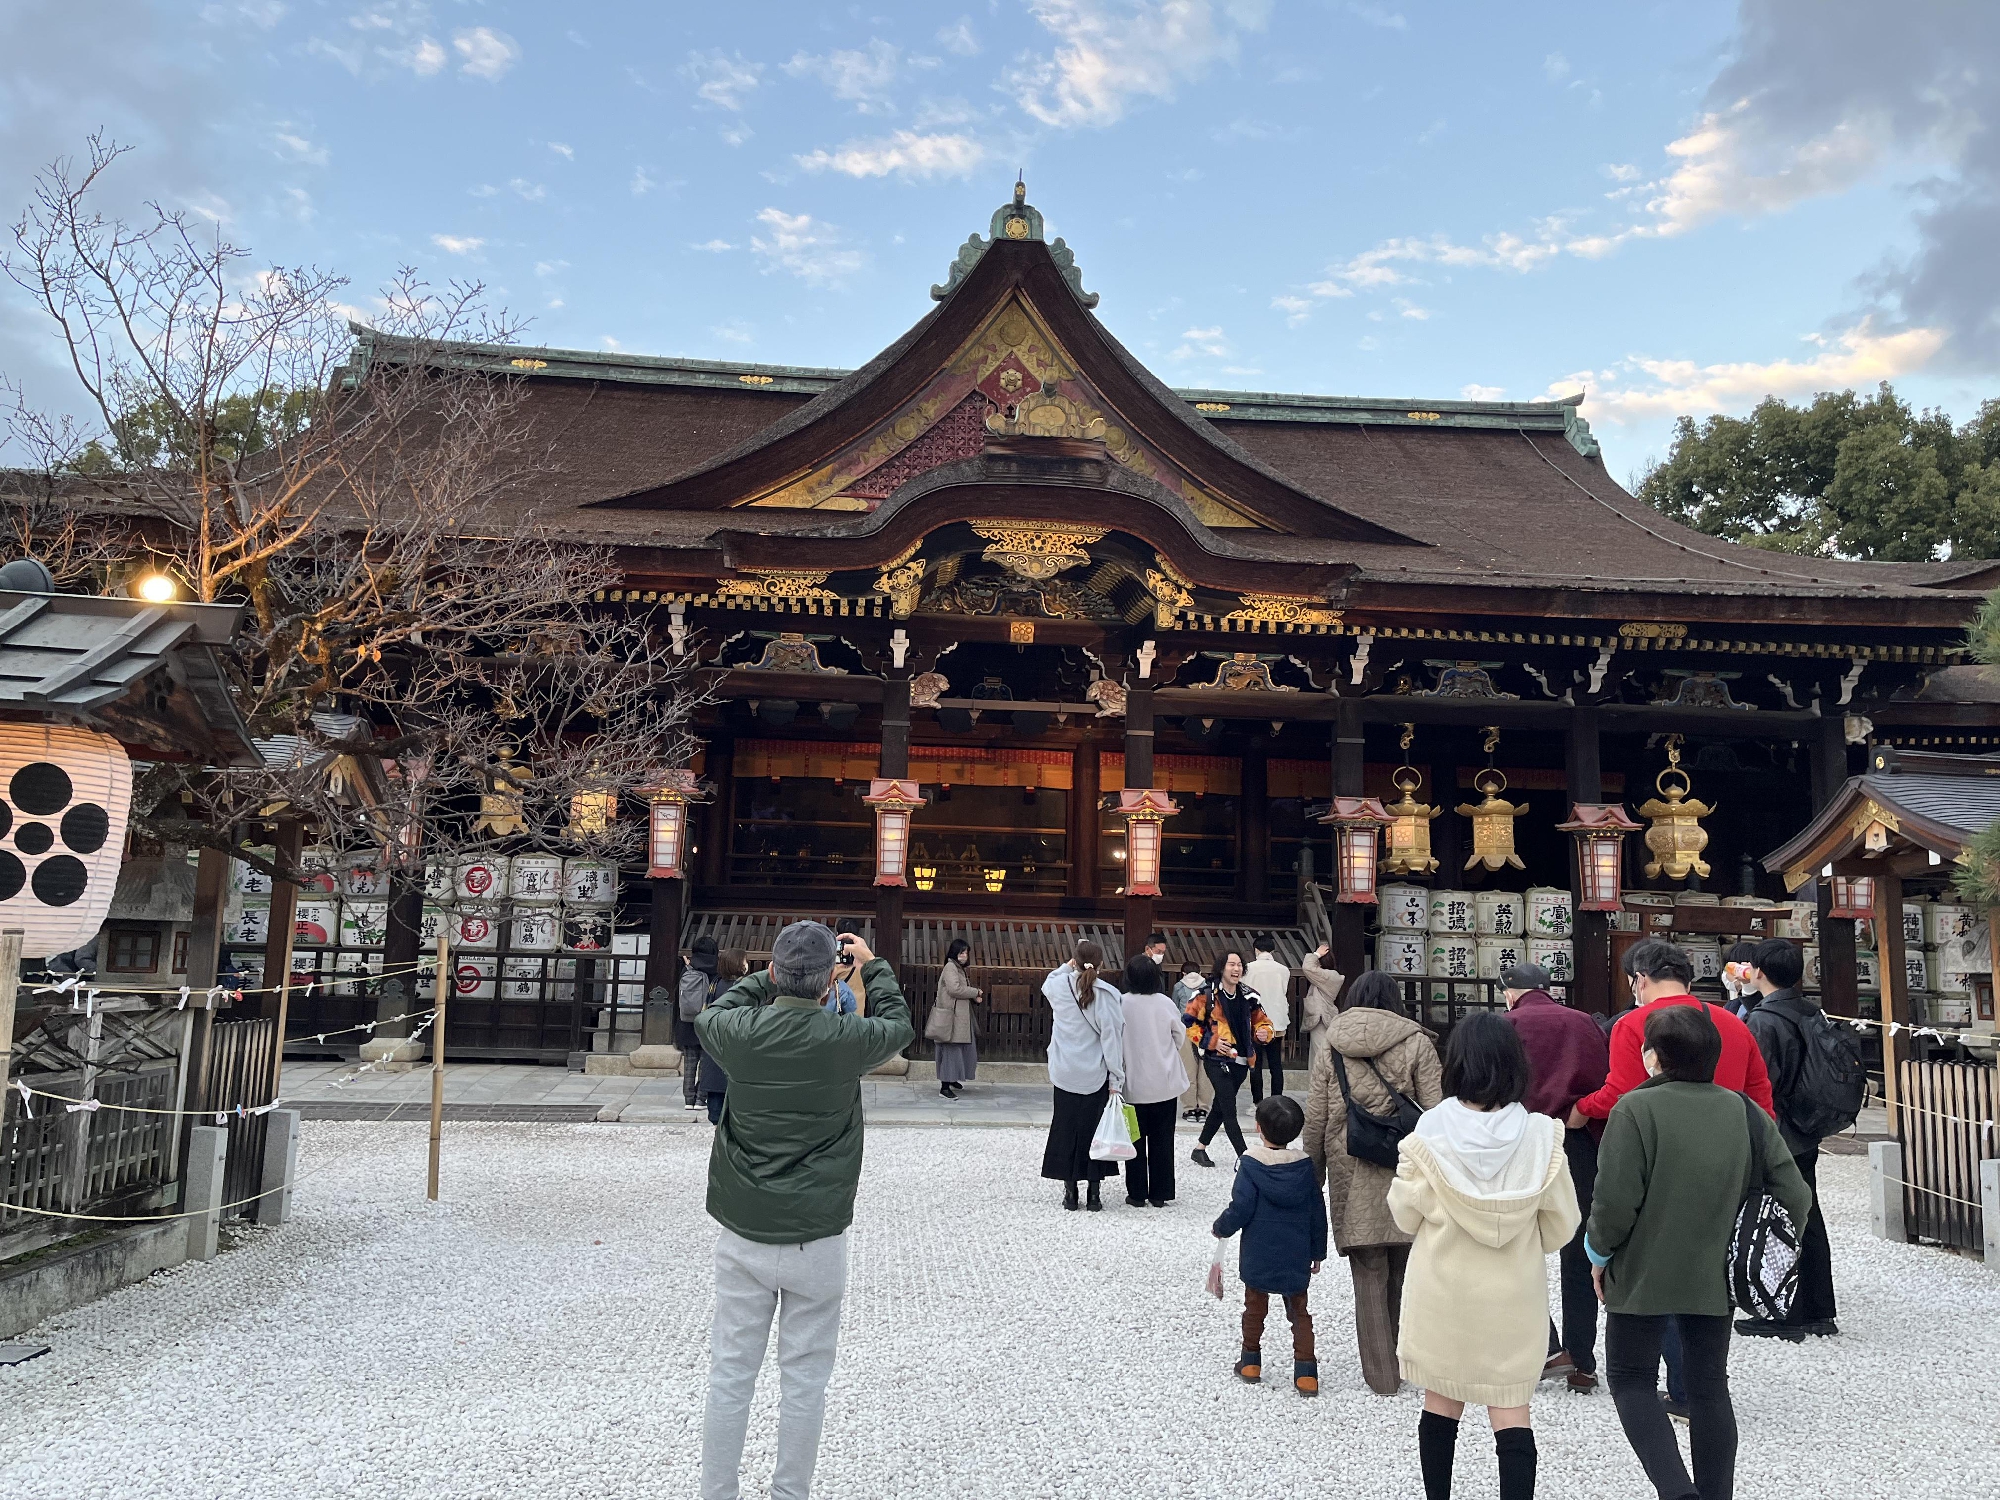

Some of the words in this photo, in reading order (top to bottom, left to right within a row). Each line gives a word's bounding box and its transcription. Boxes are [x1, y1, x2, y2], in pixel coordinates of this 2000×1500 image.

[239, 911, 261, 942] 長老
[296, 908, 309, 943] 櫻正宗
[1406, 897, 1420, 927] 山本
[1550, 905, 1570, 934] 富翁
[1903, 914, 1921, 942] 神聖
[1403, 944, 1417, 972] 山本
[1551, 951, 1570, 981] 富翁
[1703, 955, 1713, 976] 白鶴
[1907, 960, 1926, 989] 神聖
